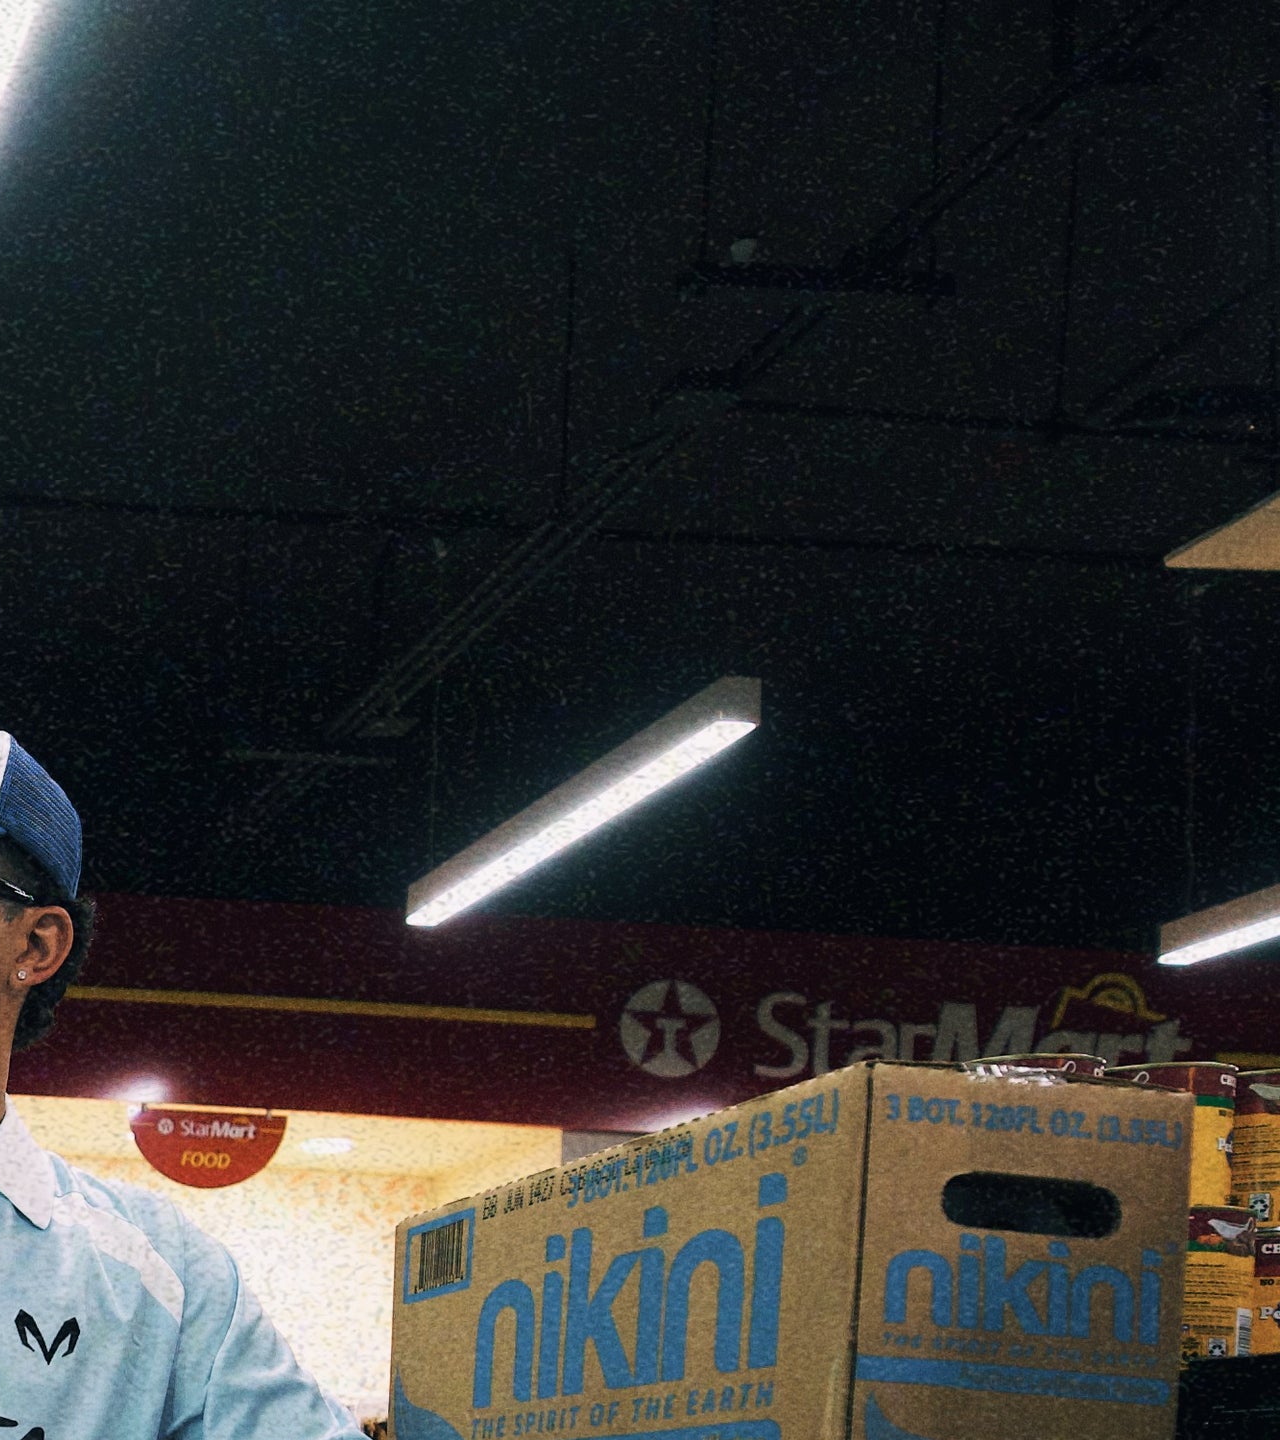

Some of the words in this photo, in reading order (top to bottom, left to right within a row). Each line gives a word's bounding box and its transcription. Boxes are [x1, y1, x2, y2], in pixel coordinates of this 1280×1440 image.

[180, 1118, 258, 1141] StarMart
[703, 1120, 744, 1166] OZ.
[748, 1088, 841, 1159] (3.55L)
[886, 1094, 902, 1120] 3
[907, 1094, 965, 1126] BOT.
[1049, 1107, 1092, 1141] OZ.
[180, 1150, 232, 1170] FOOD
[472, 1172, 788, 1410] nikini
[883, 1232, 1164, 1346] nikini
[514, 1406, 581, 1436] SPIRIT
[590, 1399, 622, 1429] OF
[631, 1392, 677, 1424] THE
[686, 1380, 776, 1418] EARTH
